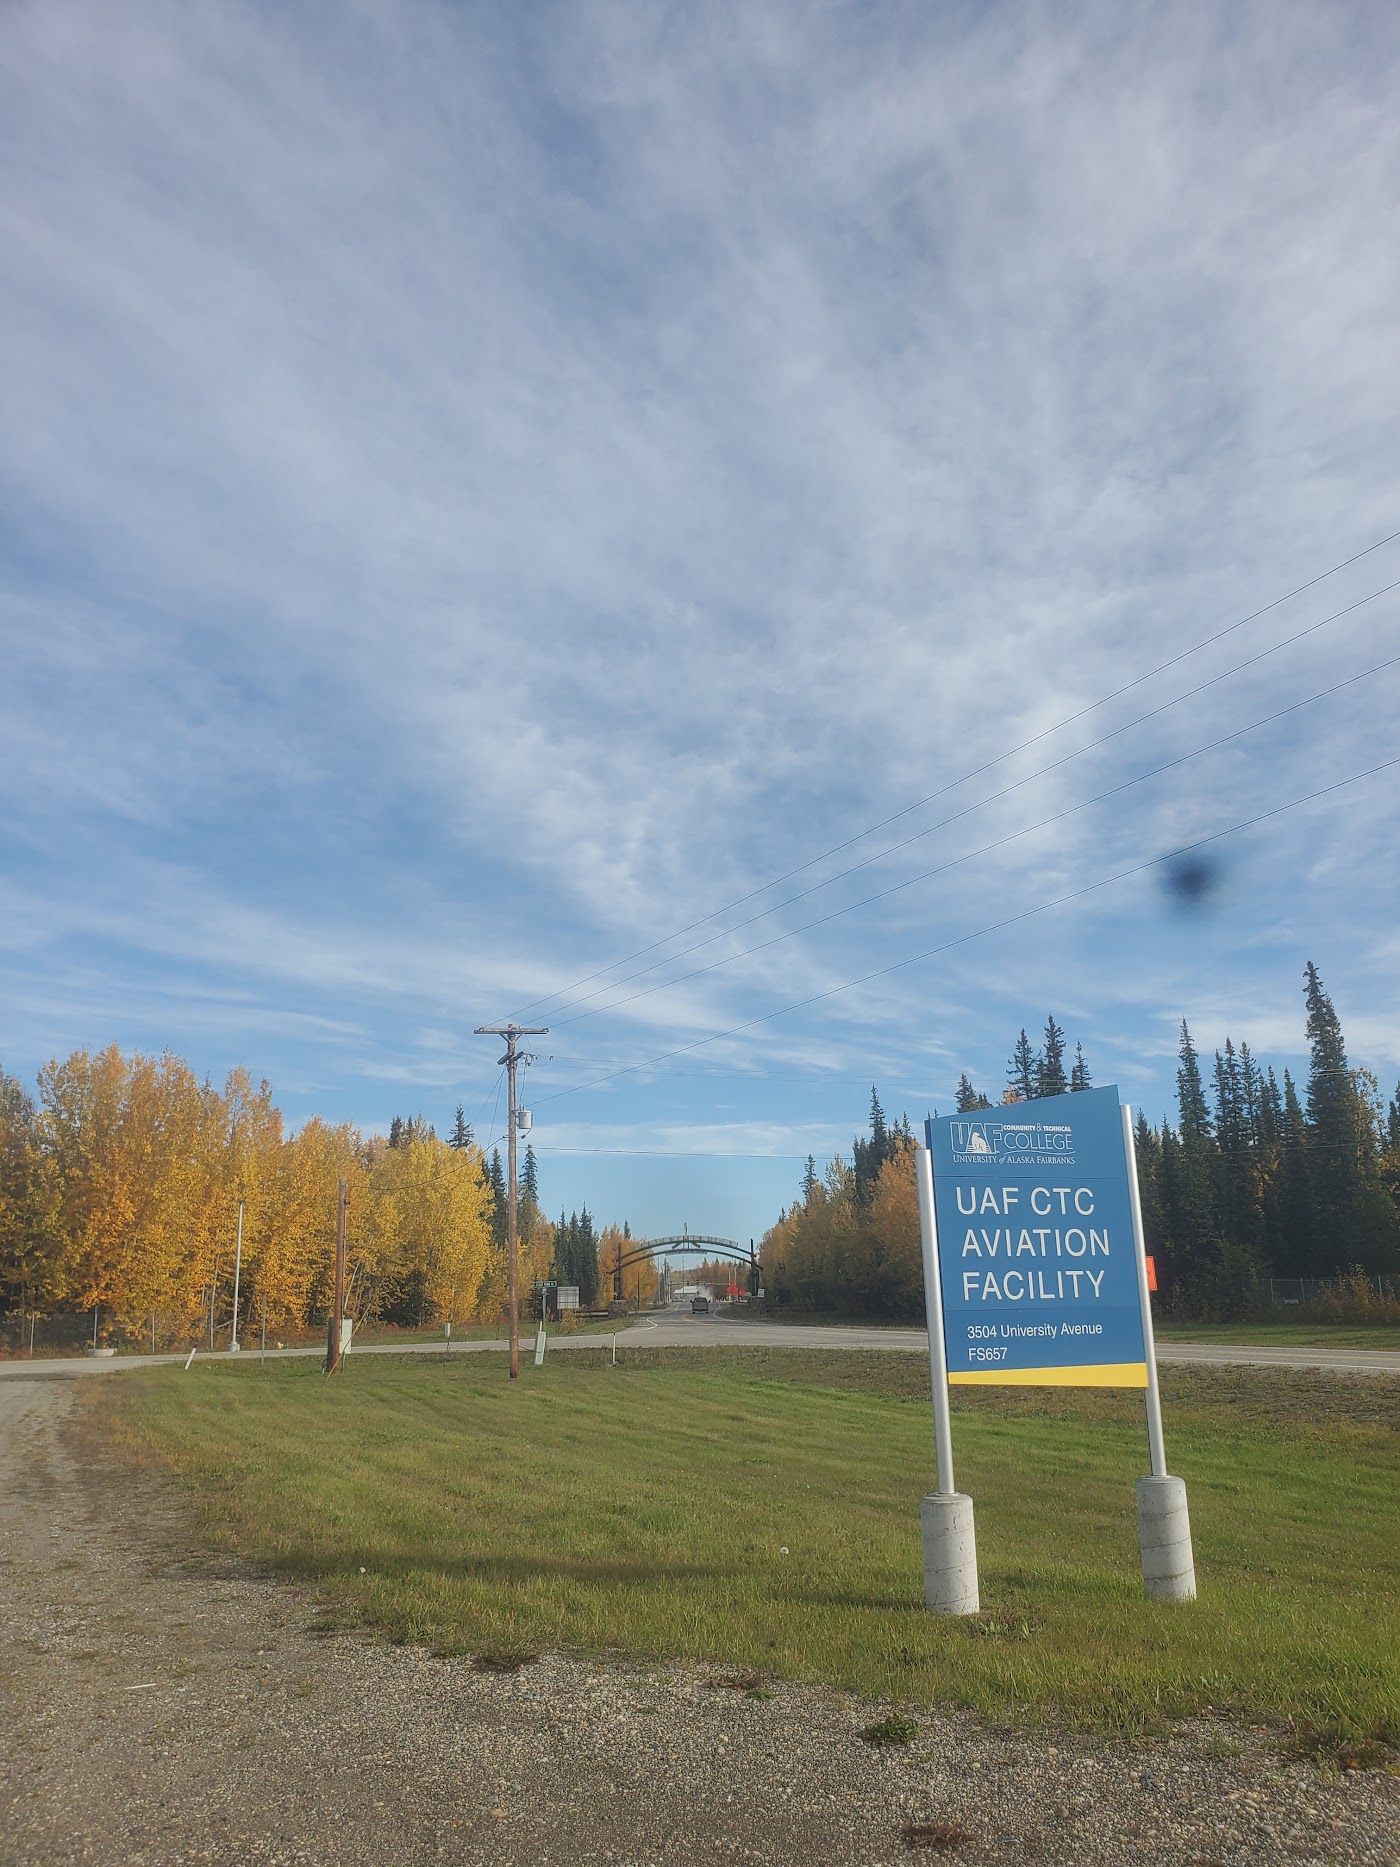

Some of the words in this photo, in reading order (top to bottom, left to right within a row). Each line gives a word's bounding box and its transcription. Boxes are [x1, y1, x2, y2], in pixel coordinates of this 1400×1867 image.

[1036, 1122, 1042, 1132] &
[950, 1122, 1003, 1154] UAF
[1004, 1132, 1074, 1150] COLLEGE
[953, 1154, 997, 1164] UNIVERSITY
[998, 1155, 1006, 1164] of
[1007, 1155, 1035, 1164] ALASKA
[1036, 1155, 1076, 1165] FAIRBANKS
[956, 1186, 1019, 1215] UAF
[1031, 1187, 1095, 1216] CTC
[961, 1228, 1110, 1257] AVIATION
[962, 1270, 1105, 1300] FACILITY
[967, 1325, 998, 1339] 3504
[1000, 1323, 1057, 1339] University
[1061, 1322, 1103, 1335] Avenue
[968, 1347, 1008, 1361] FS657
